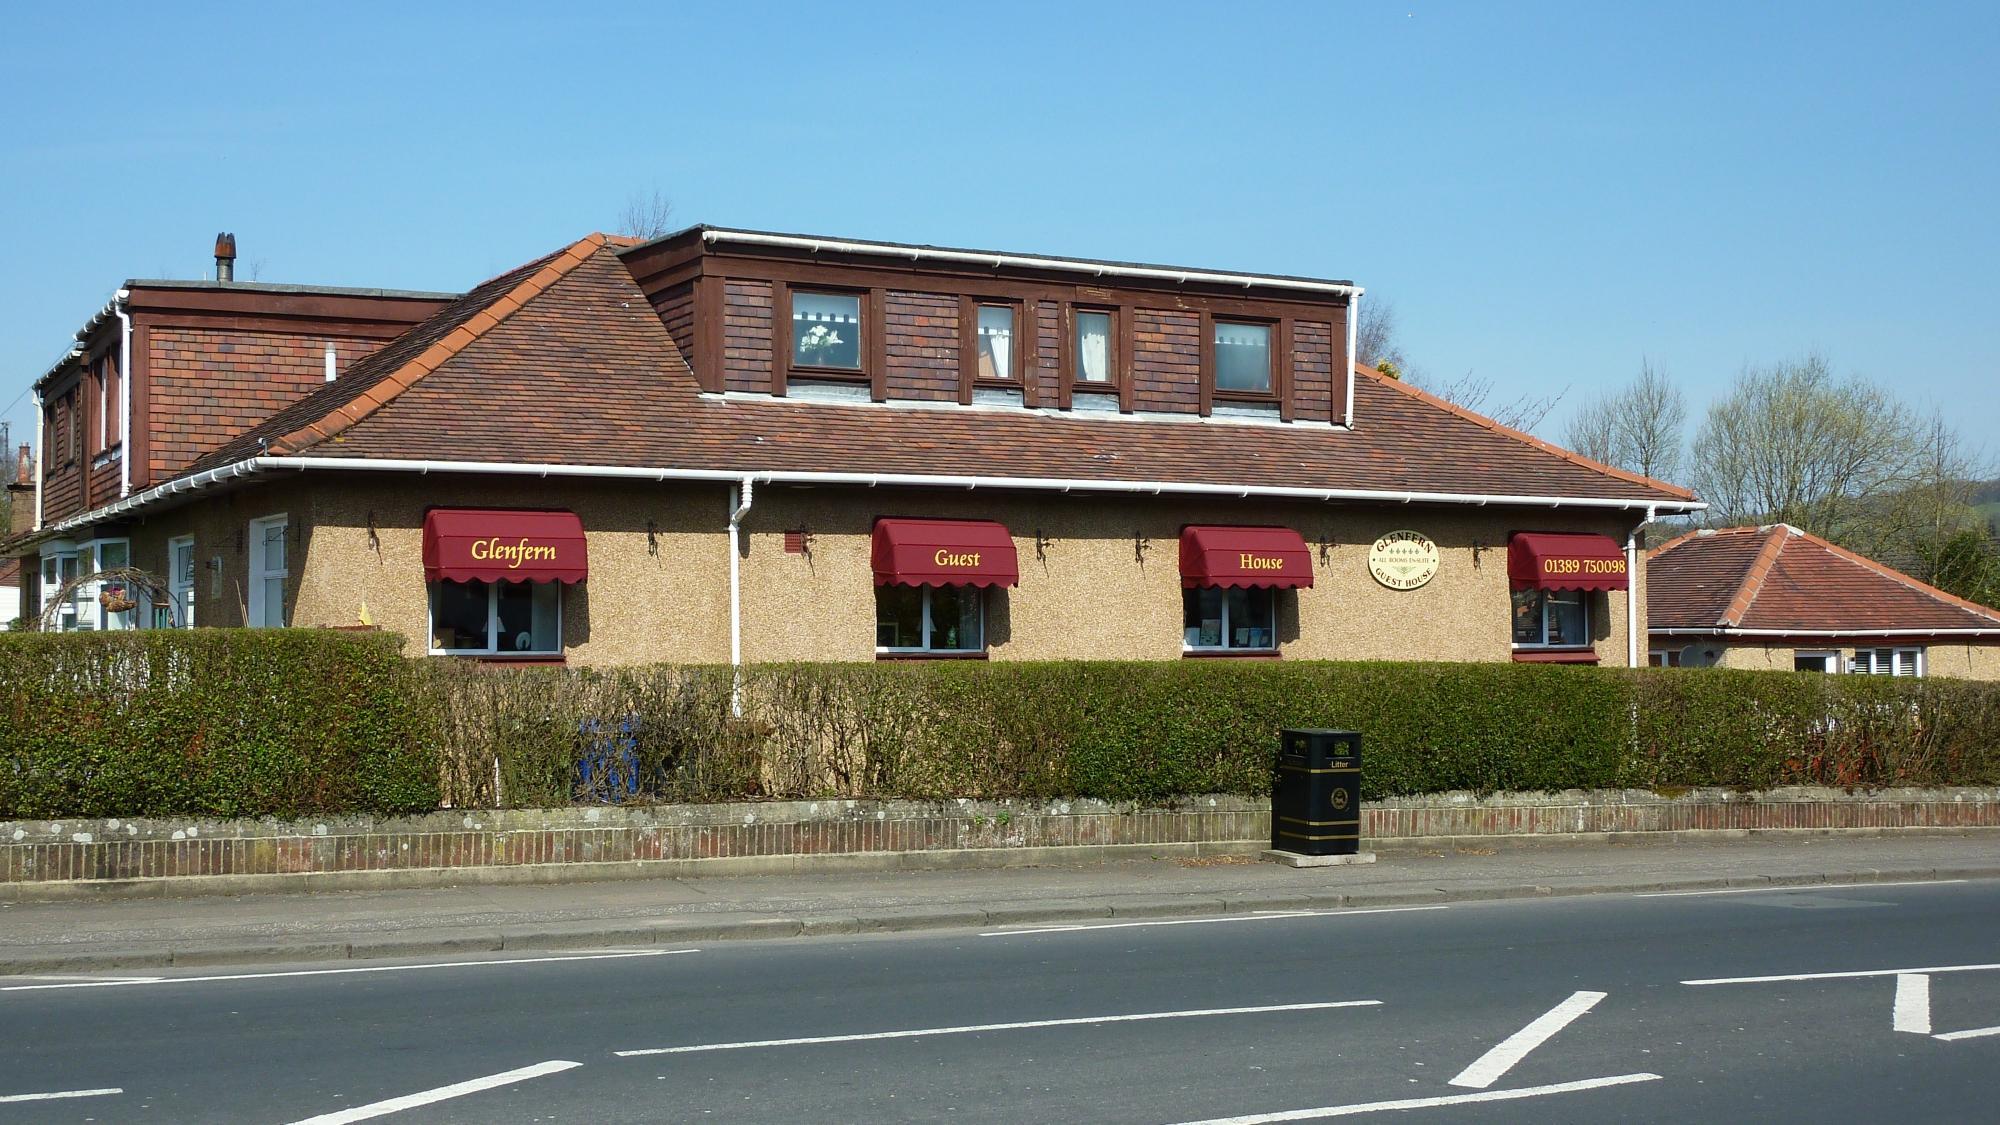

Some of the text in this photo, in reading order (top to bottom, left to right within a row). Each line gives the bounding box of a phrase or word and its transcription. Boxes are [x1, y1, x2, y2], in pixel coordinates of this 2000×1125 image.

[1376, 532, 1433, 554] GLENFERN
[471, 537, 557, 569] Glenfern
[934, 549, 981, 567] Guest
[1239, 553, 1283, 569] House
[1544, 559, 1626, 574] 01389 750098
[1376, 568, 1432, 587] GUEST HOUSE
[1331, 761, 1349, 769] Litter
